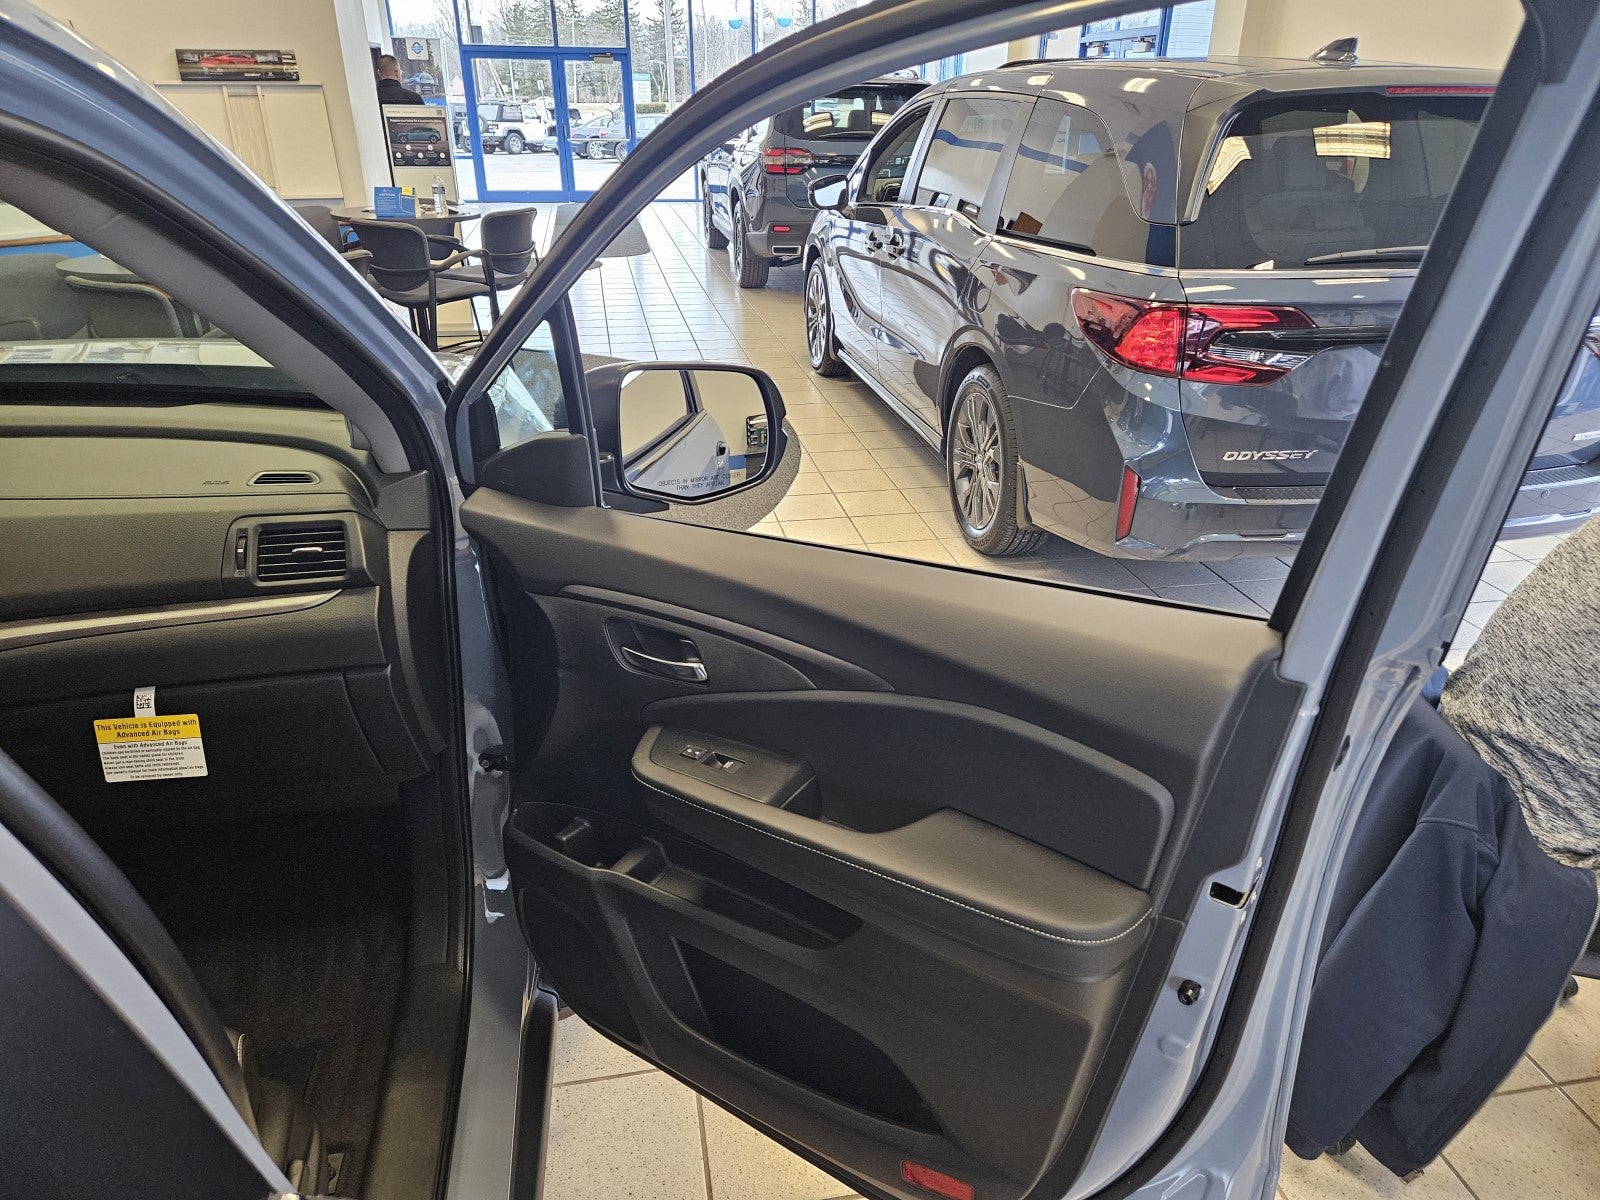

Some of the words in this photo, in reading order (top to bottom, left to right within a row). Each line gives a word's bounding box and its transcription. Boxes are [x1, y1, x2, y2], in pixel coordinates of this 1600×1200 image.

[1222, 449, 1319, 461] ODYSSEY
[658, 479, 680, 487] OBJECTS
[113, 722, 139, 730] Vehicle
[148, 720, 181, 728] Equipped
[117, 730, 150, 738] Advanced
